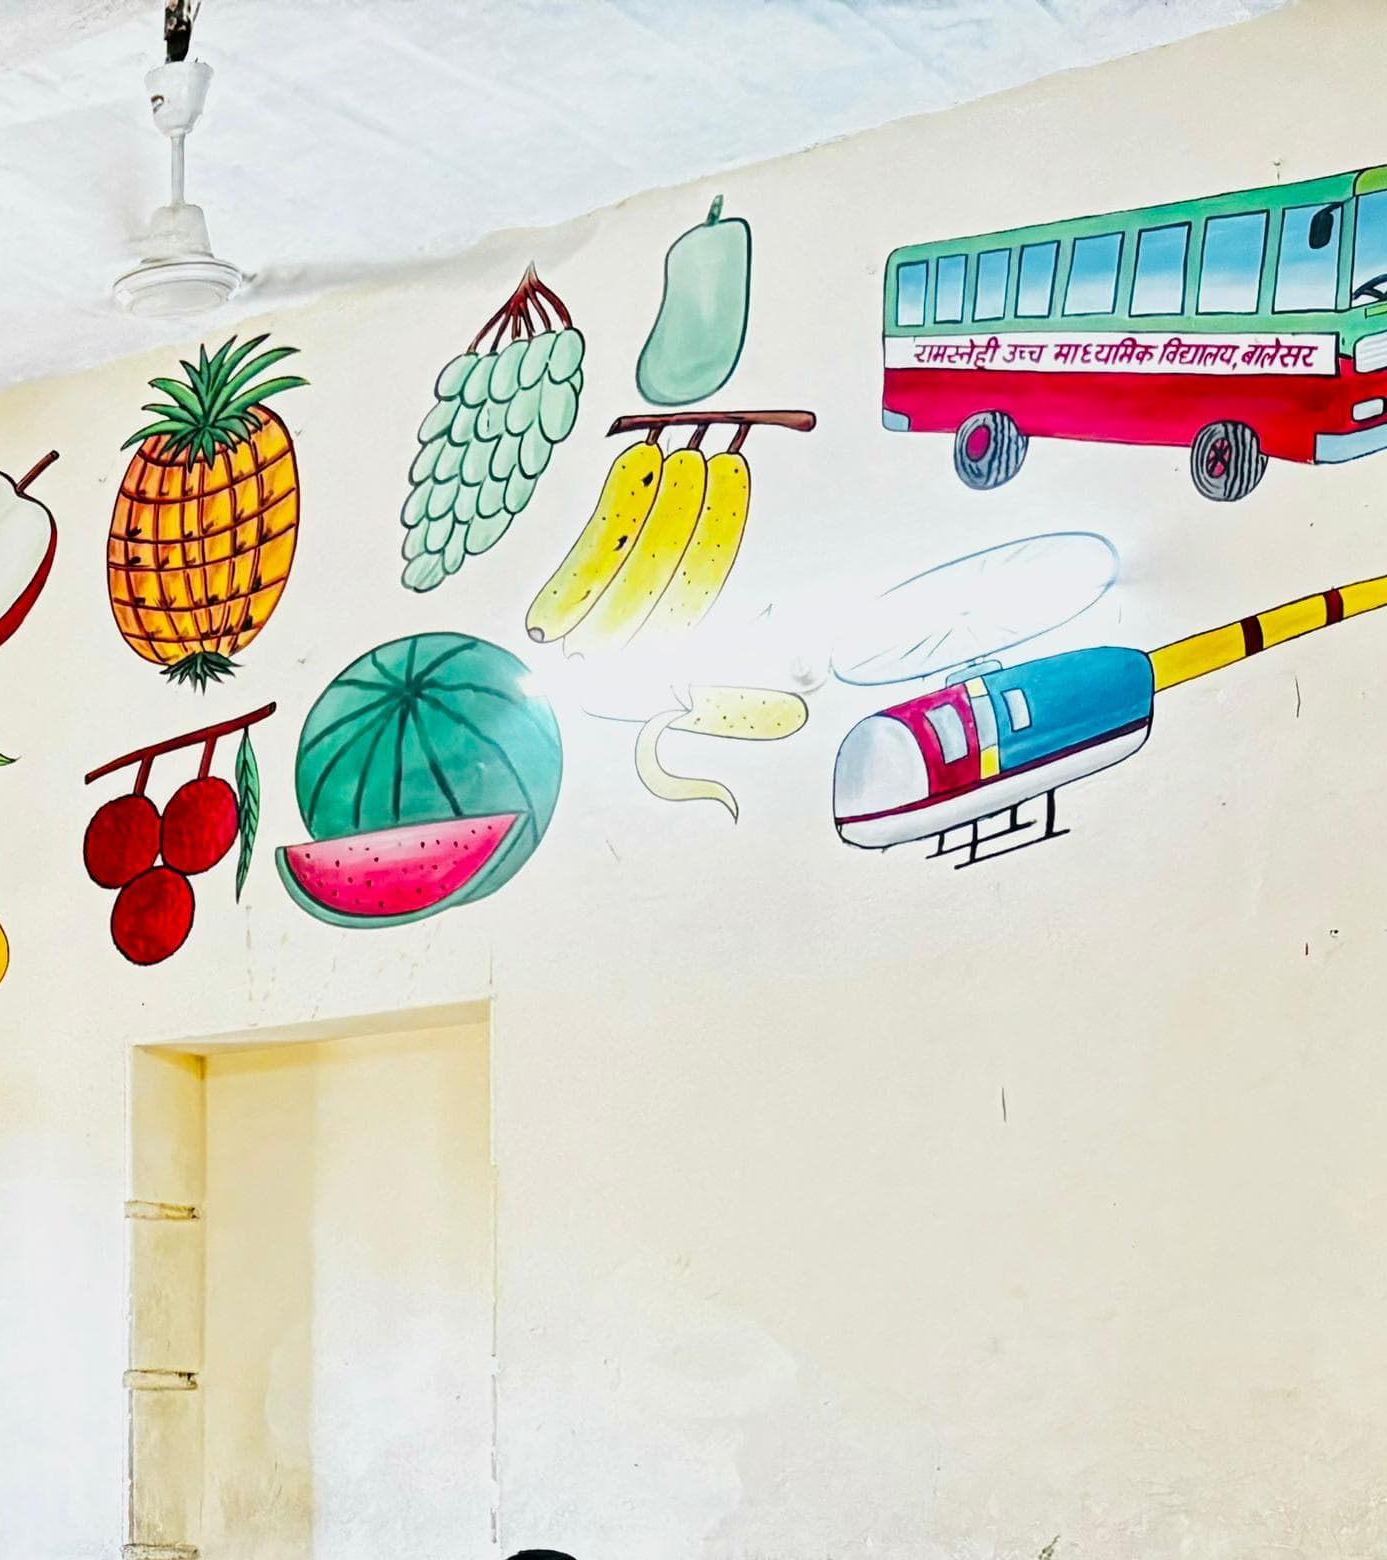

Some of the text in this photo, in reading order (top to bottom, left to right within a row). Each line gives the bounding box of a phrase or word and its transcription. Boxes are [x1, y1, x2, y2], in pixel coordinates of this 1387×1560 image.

[914, 336, 1000, 368] रामस्नेही
[1003, 344, 1048, 364] उच्च
[1053, 337, 1158, 364] माध्यमिक
[1240, 337, 1319, 367] बालेसर
